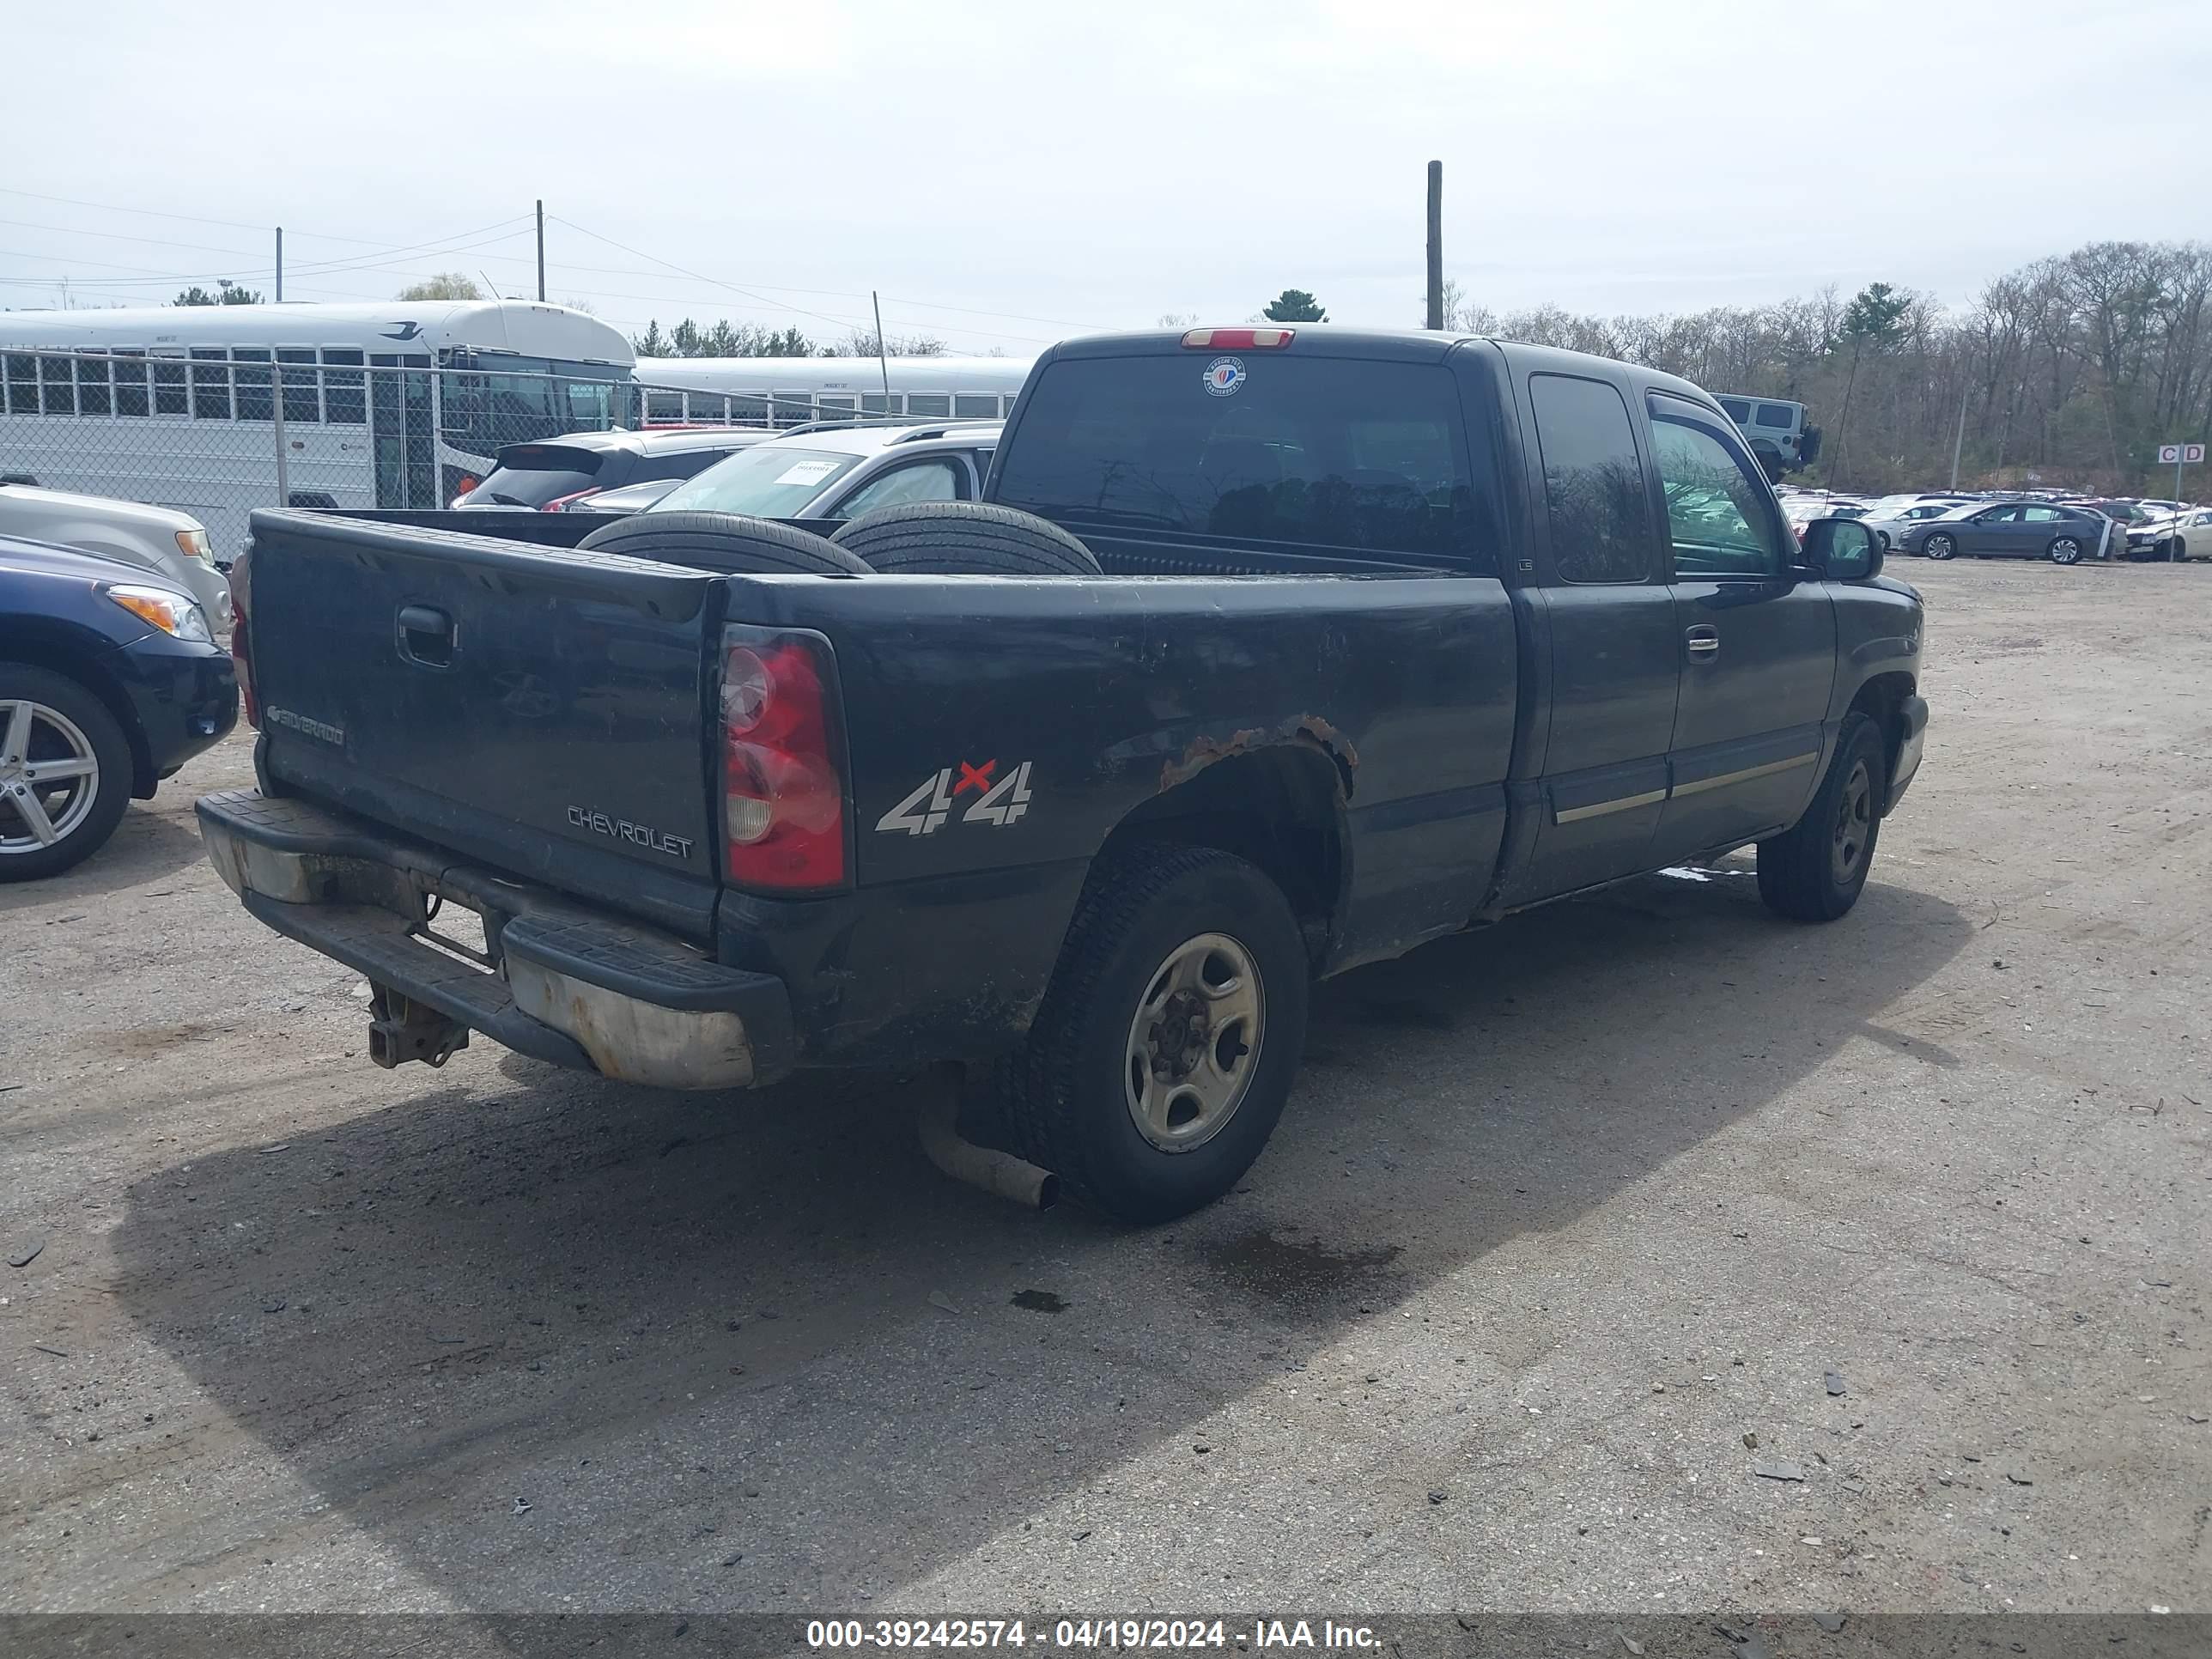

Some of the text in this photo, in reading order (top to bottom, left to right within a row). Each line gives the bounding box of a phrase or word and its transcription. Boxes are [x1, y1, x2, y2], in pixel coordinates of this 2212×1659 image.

[2162, 447, 2176, 461] C
[2186, 446, 2201, 461] D
[1519, 562, 1533, 571] LS
[279, 708, 344, 745] SILVERADO
[568, 805, 694, 858] CHEVROLET
